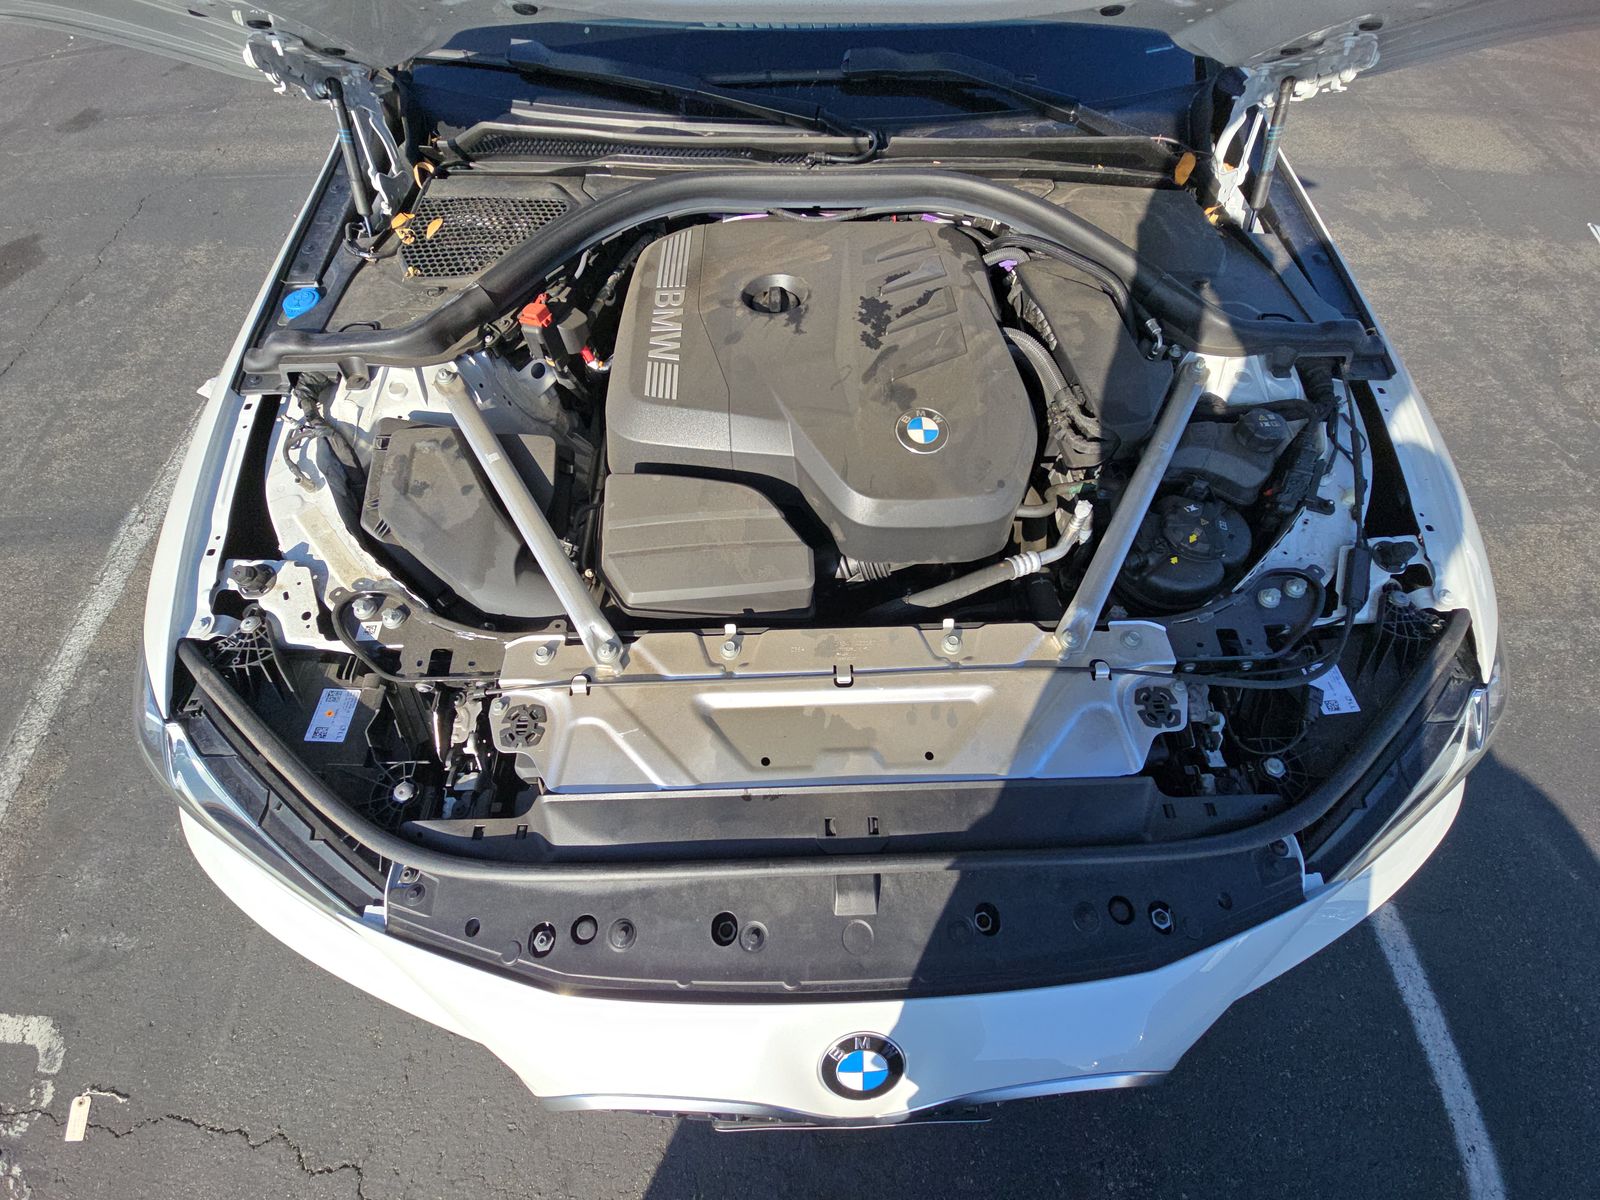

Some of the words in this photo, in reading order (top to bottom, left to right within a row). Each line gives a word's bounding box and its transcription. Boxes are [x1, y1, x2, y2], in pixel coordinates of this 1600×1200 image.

[648, 289, 686, 361] BMW
[901, 410, 943, 424] BMW
[828, 1036, 899, 1061] BMW
